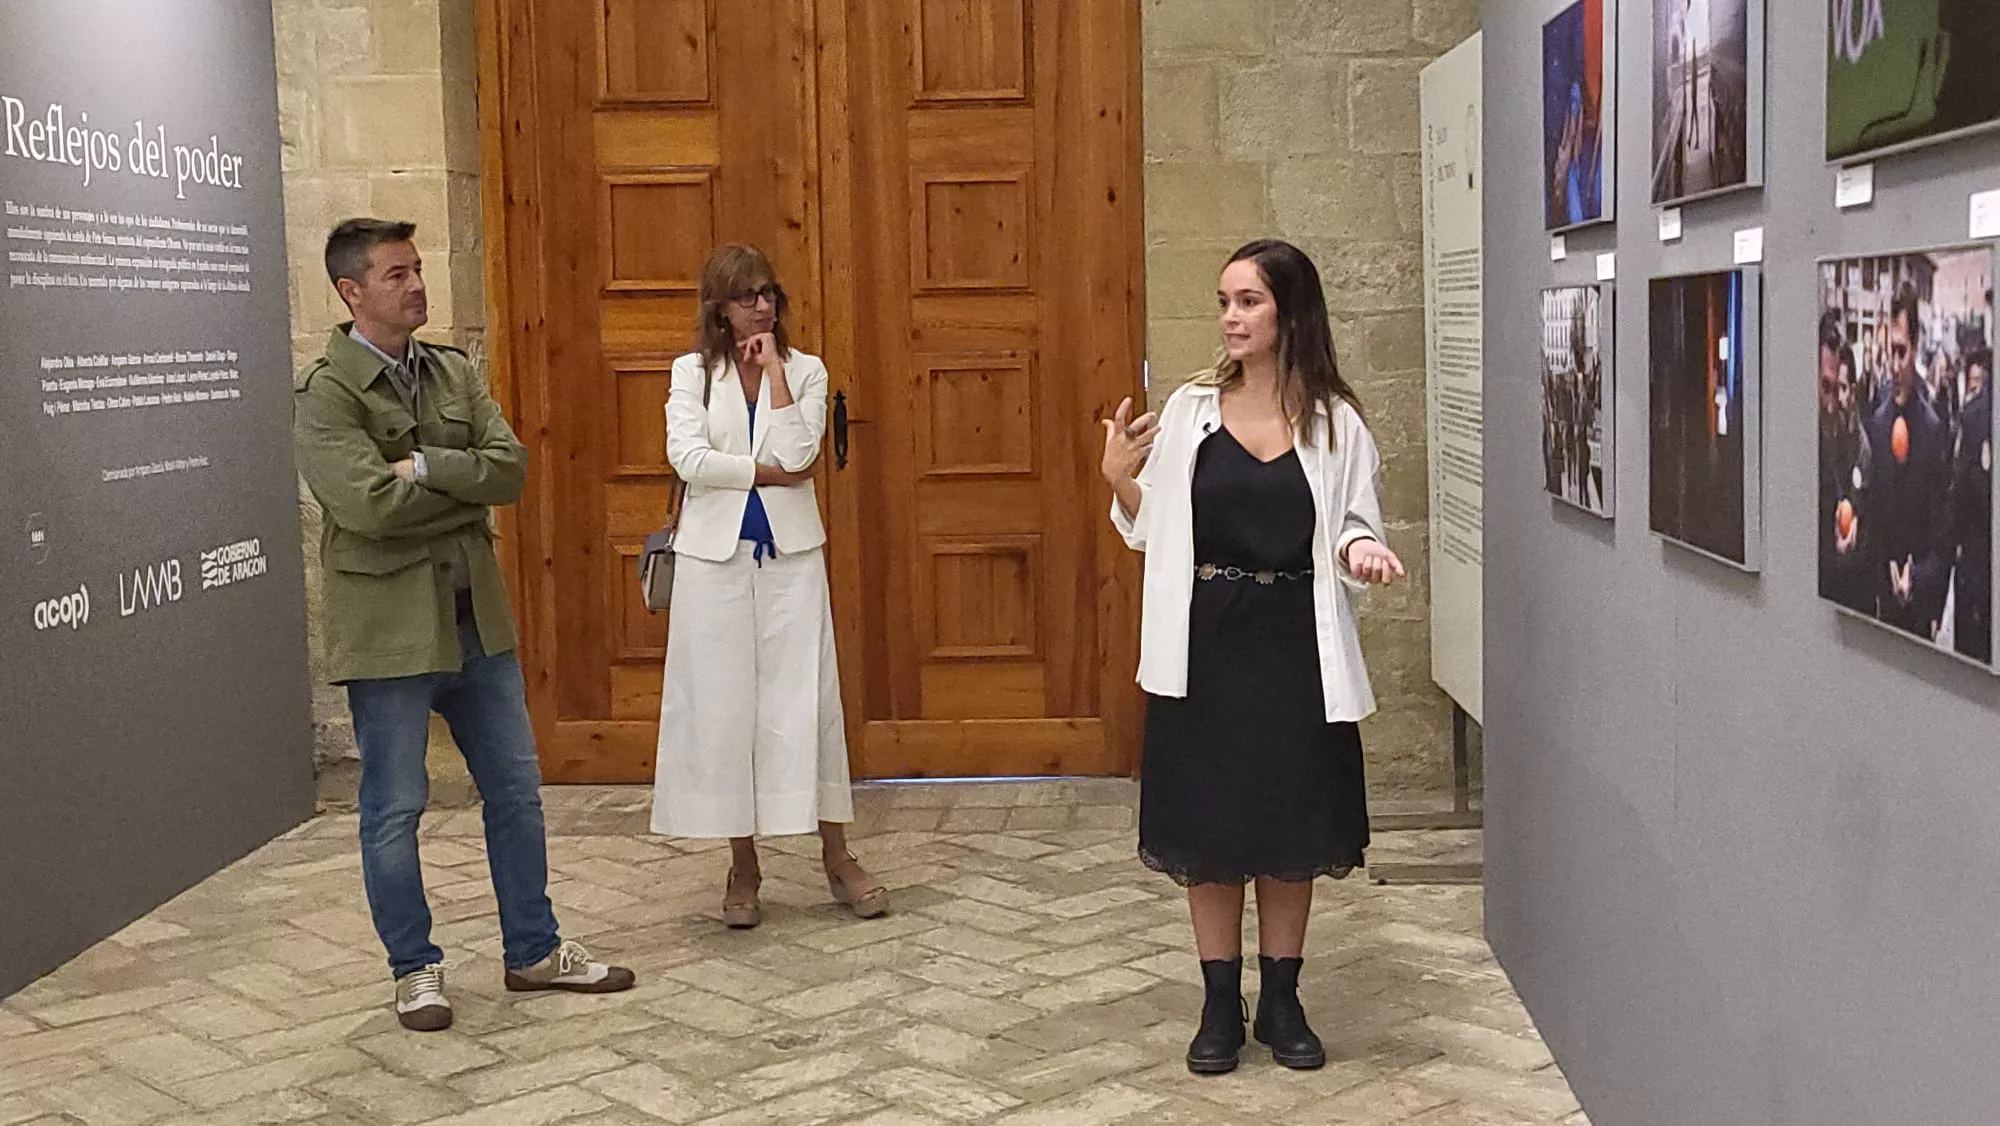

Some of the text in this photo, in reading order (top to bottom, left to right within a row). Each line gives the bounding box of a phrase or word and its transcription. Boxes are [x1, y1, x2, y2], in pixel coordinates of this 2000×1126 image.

[1832, 0, 1884, 60] VOX
[2, 96, 243, 199] Reflejos del poder
[217, 538, 261, 566] GOBIERNO
[217, 567, 231, 585] DE
